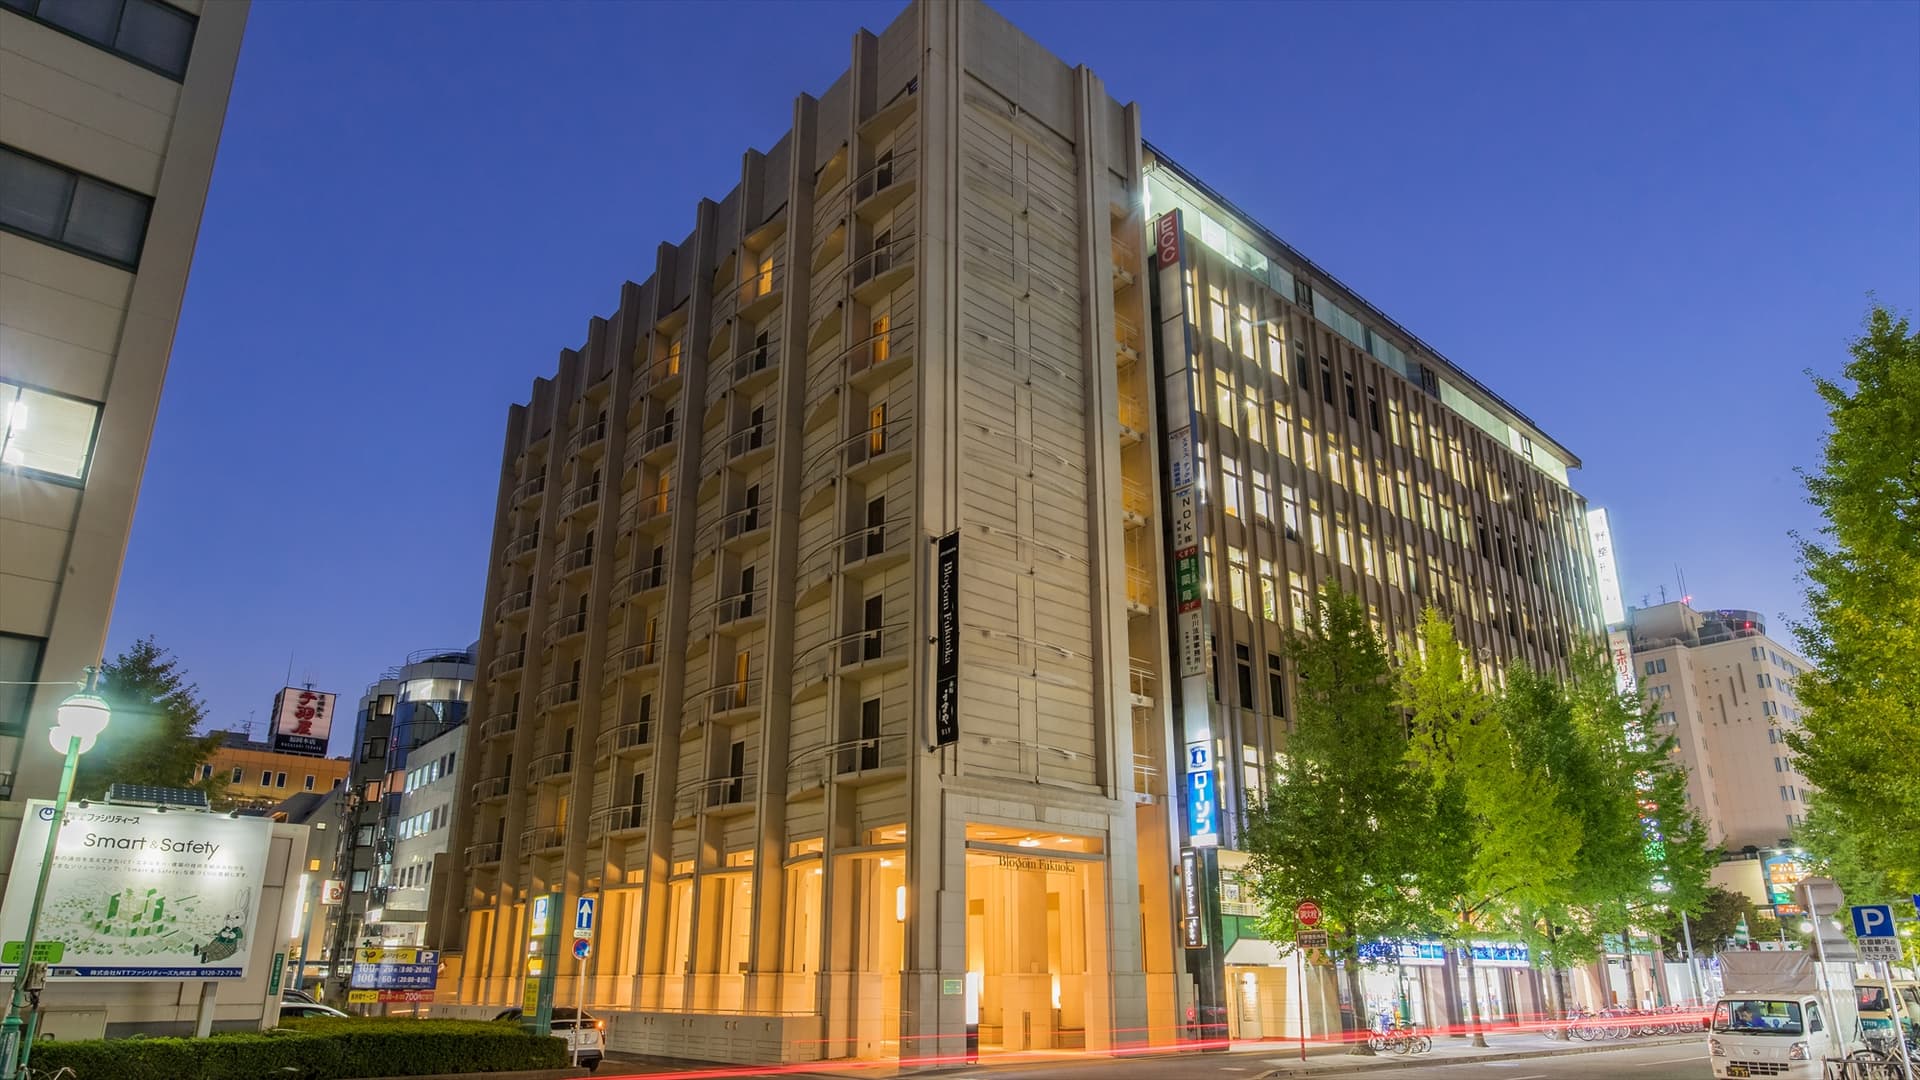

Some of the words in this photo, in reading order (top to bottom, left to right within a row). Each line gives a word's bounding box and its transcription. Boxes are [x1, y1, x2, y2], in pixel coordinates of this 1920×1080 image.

[1161, 215, 1175, 262] ECC
[943, 612, 954, 665] Fukuoka
[1194, 771, 1211, 836] ローソン
[83, 833, 147, 851] Smart
[150, 840, 157, 849] &
[160, 838, 220, 861] Safety
[1039, 858, 1076, 873] Fukuoka
[1861, 908, 1884, 934] P
[421, 951, 434, 963] P
